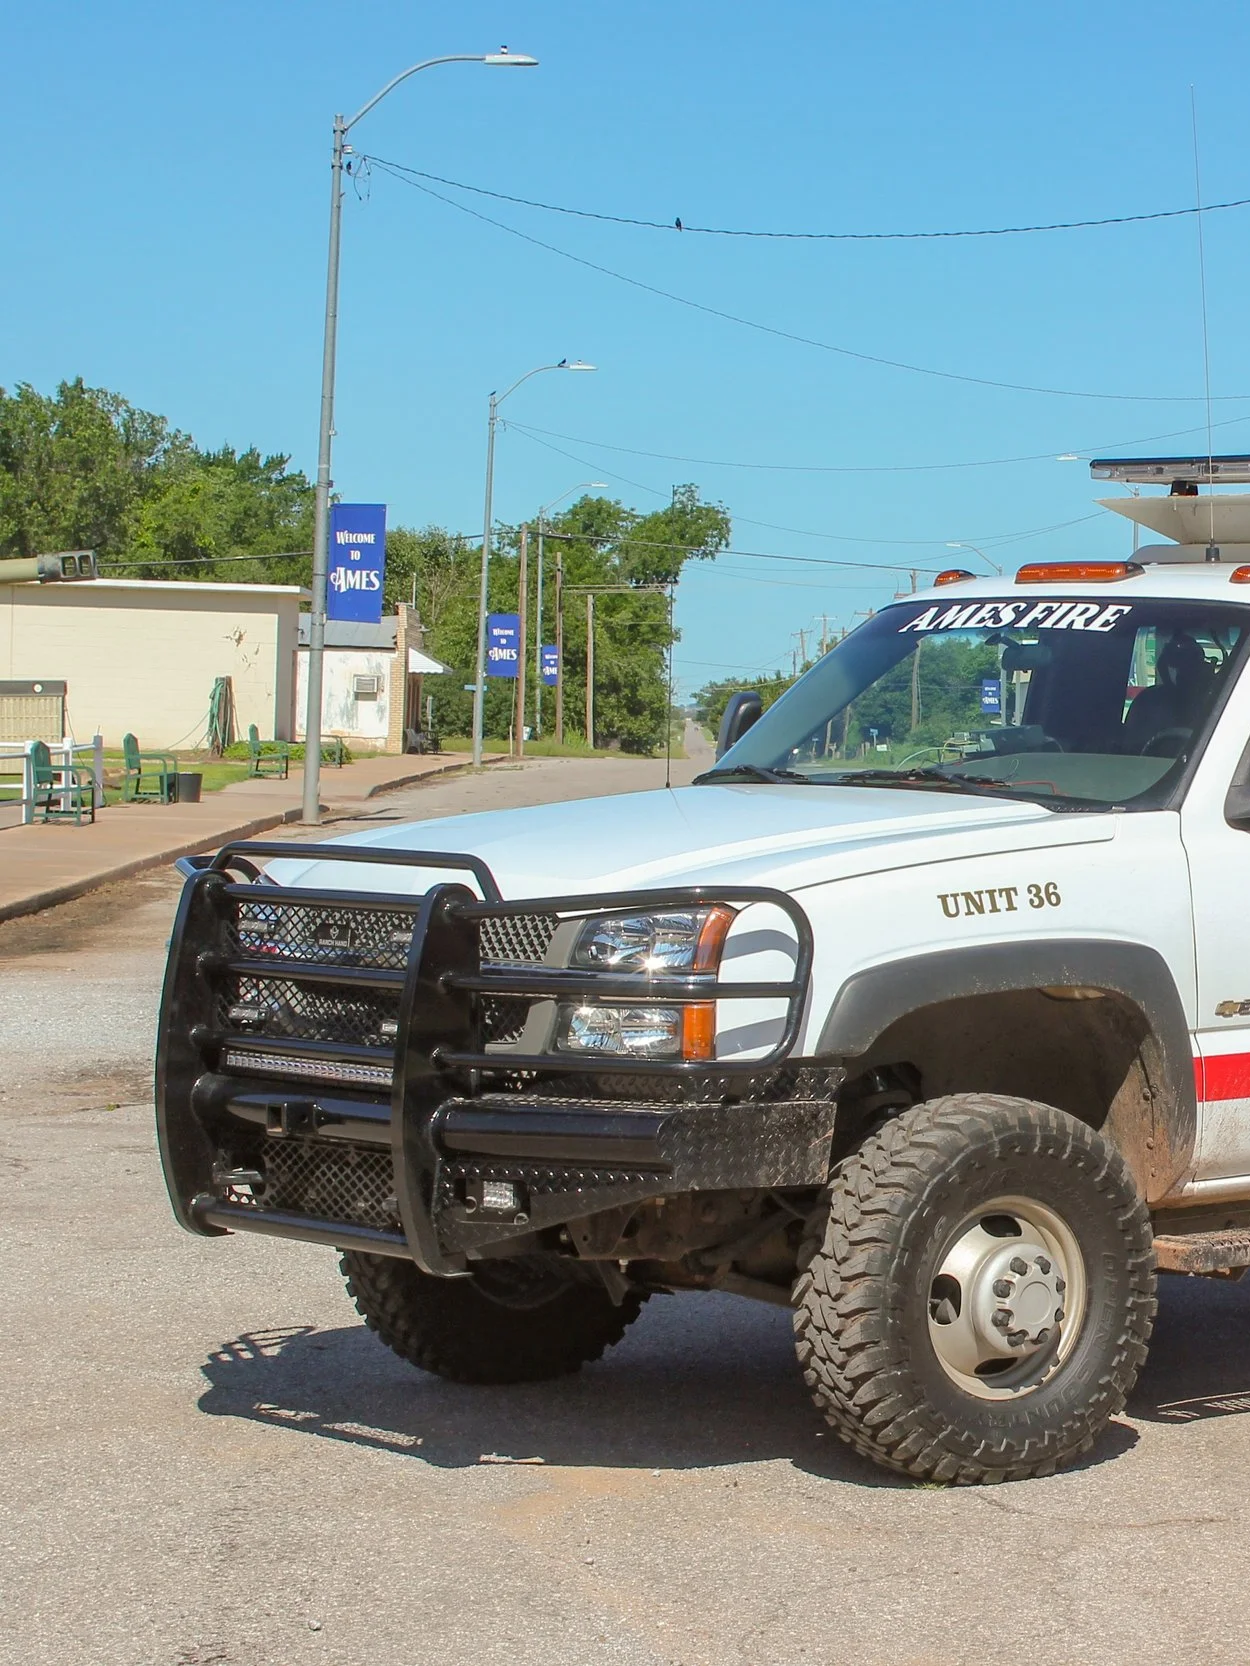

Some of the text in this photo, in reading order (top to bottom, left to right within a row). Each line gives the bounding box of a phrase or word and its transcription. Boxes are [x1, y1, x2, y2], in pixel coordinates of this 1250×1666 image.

[336, 530, 376, 546] WELCOME
[349, 550, 361, 561] TO
[330, 567, 380, 593] AMES
[898, 602, 1132, 633] AMES FIRE
[488, 647, 517, 661] AMES
[936, 881, 1061, 918] UNIT 36
